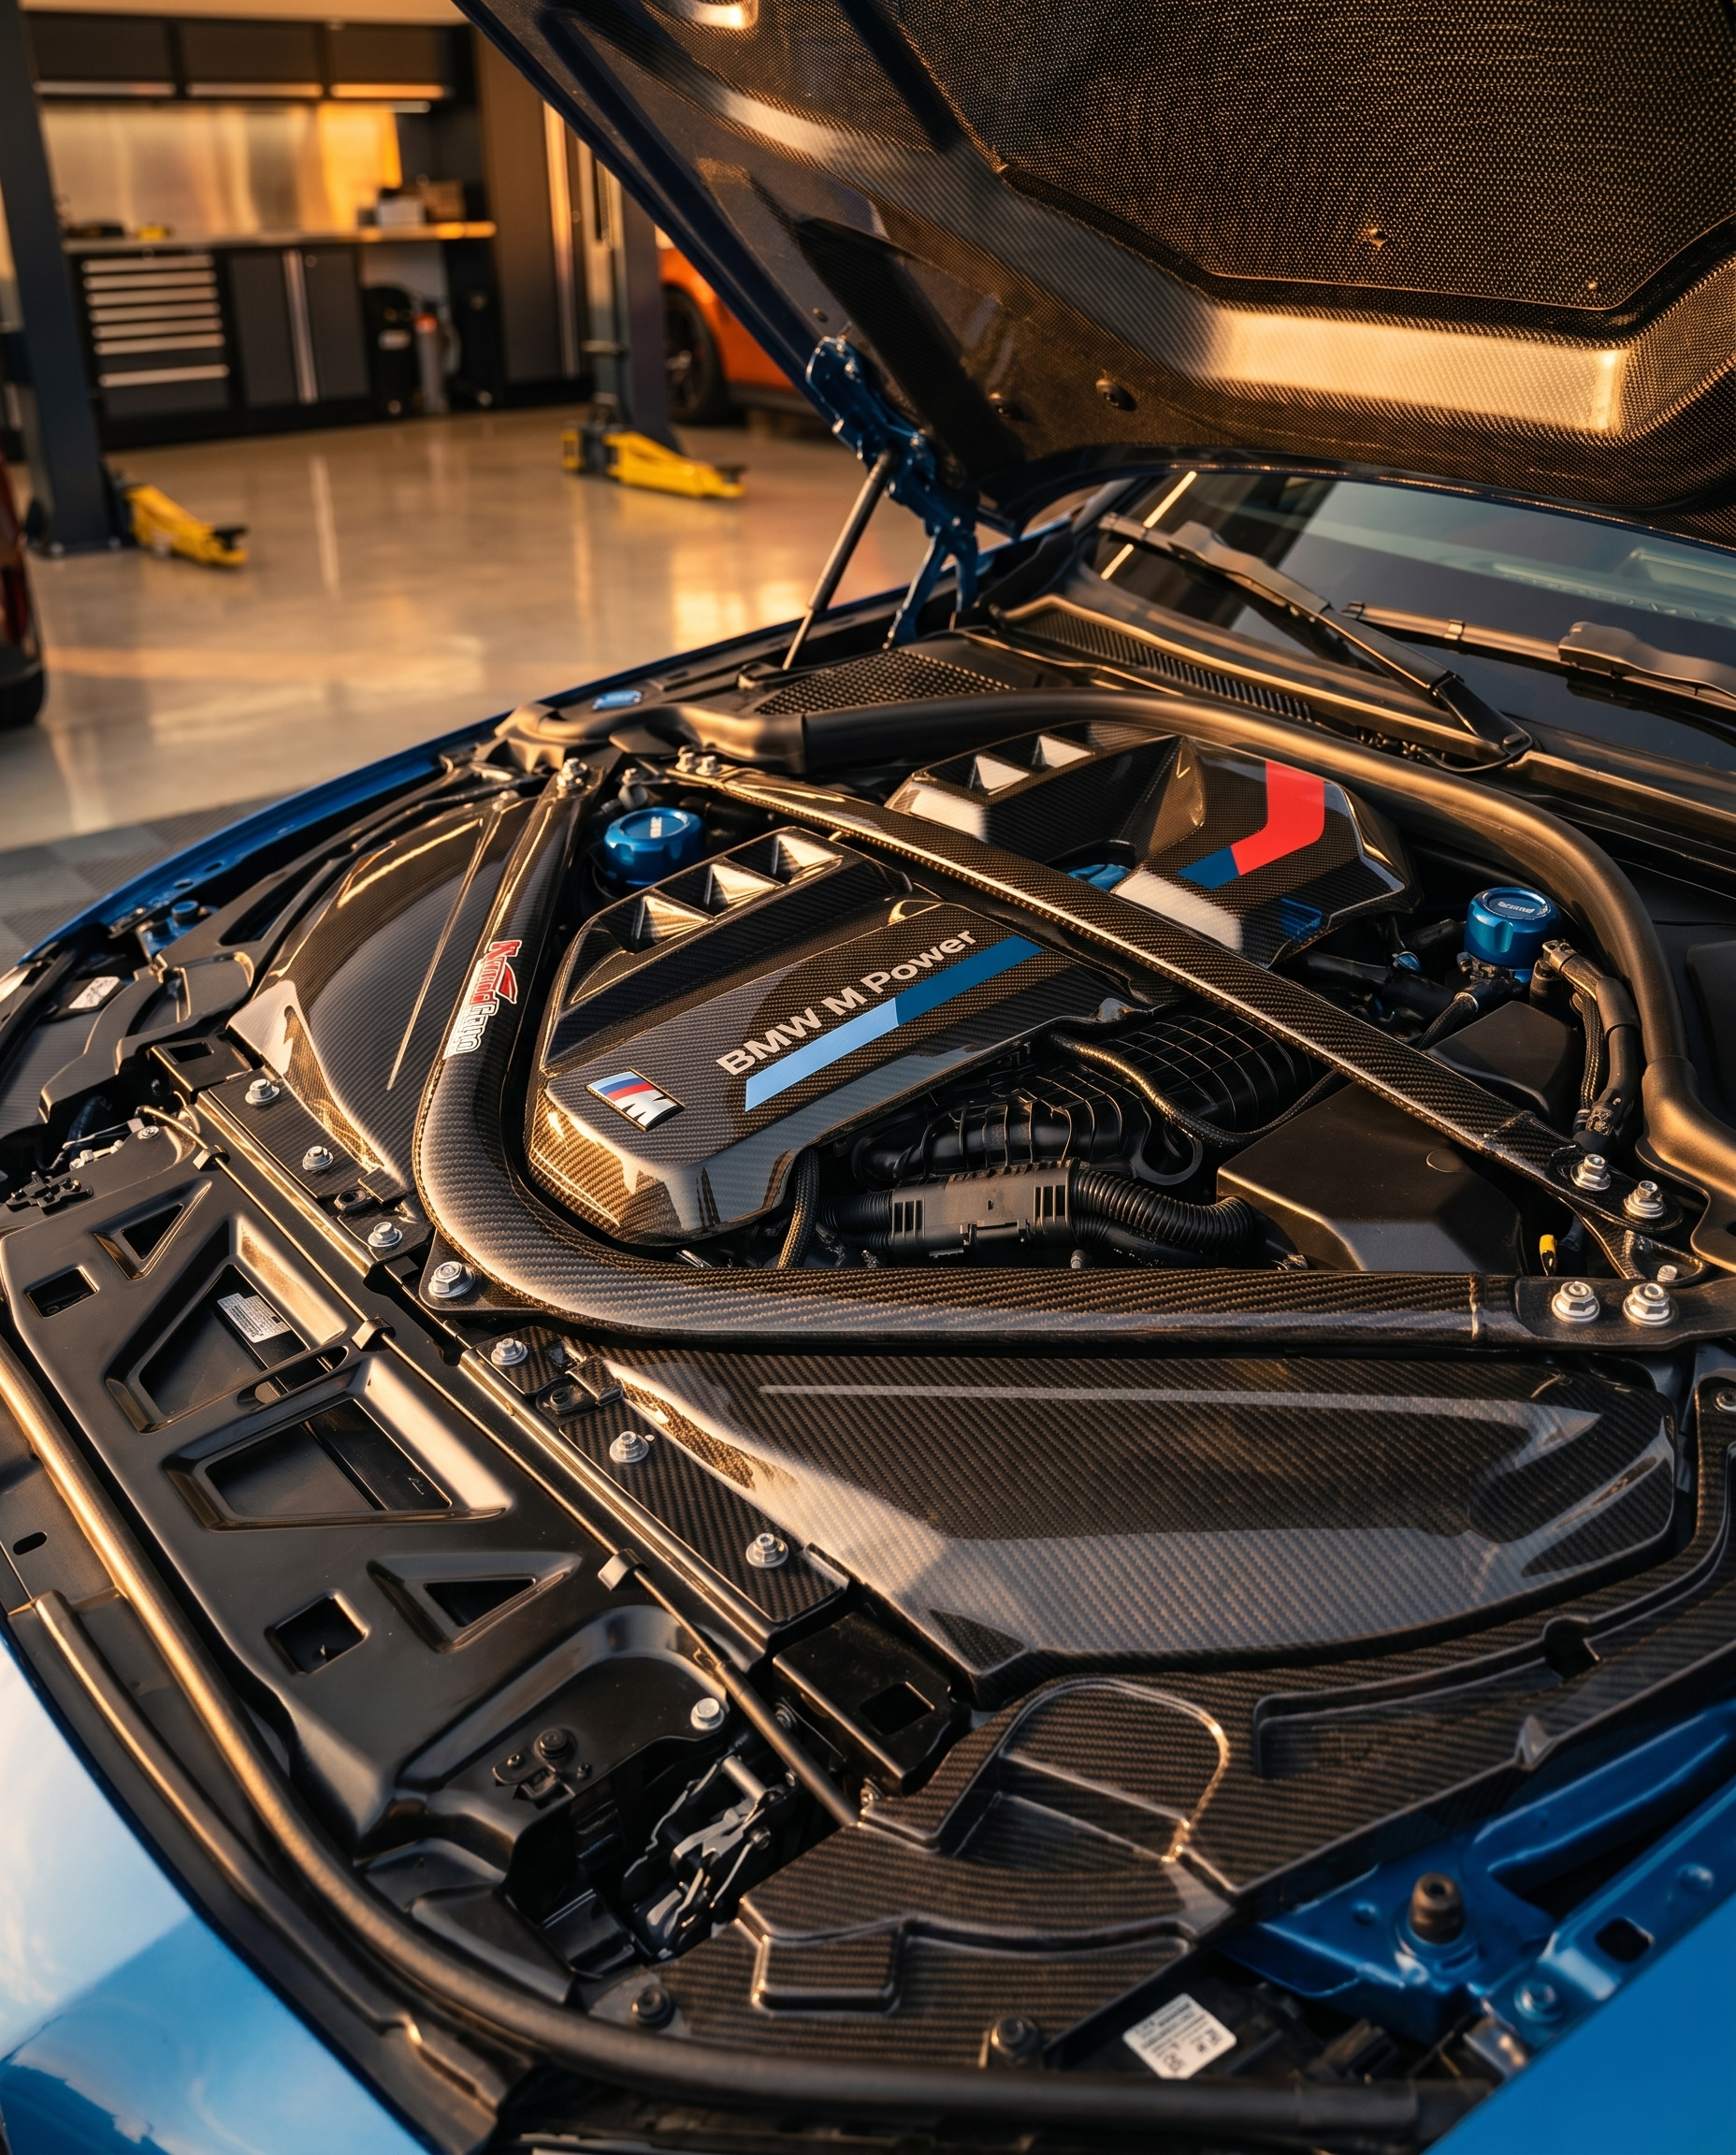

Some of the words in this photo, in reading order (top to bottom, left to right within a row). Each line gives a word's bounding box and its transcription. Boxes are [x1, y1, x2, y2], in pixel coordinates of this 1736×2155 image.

[716, 1007, 822, 1076] BMW
[820, 987, 868, 1017] M
[861, 930, 976, 993] Power
